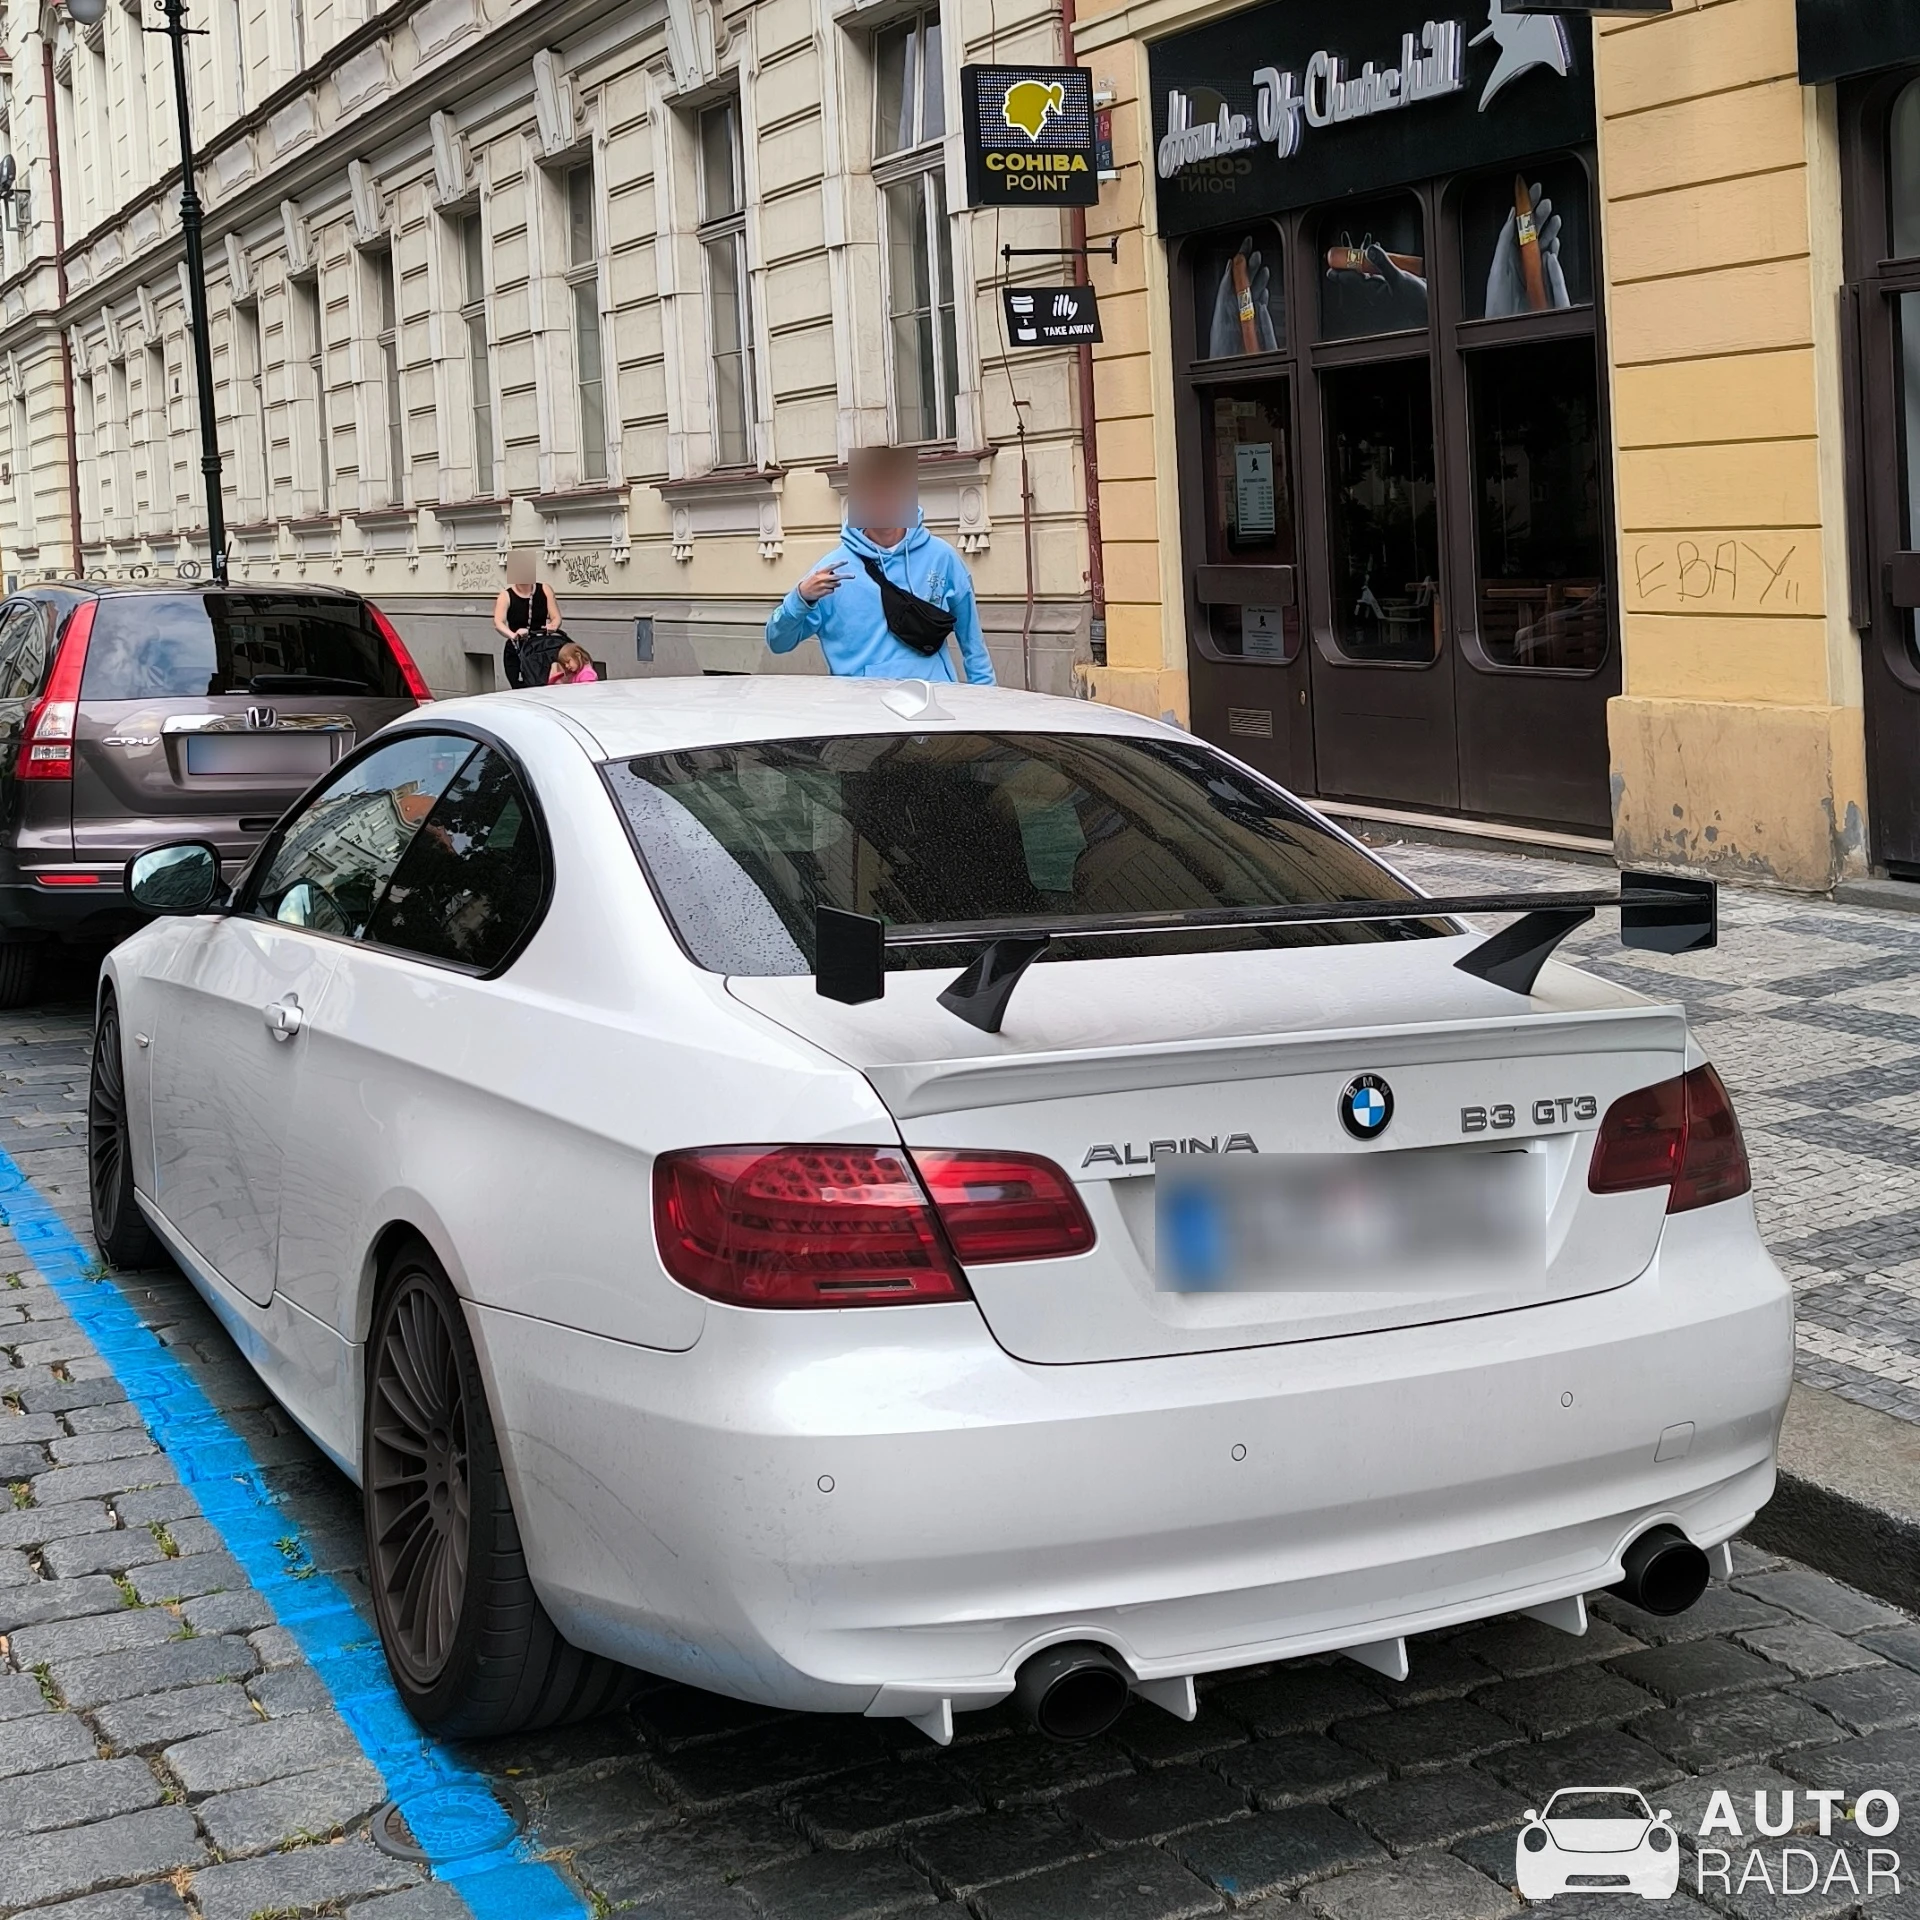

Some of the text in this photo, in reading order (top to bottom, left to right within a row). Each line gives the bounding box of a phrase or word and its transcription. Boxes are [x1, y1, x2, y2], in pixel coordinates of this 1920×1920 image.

[1158, 90, 1251, 178] House
[1253, 67, 1304, 158] Of
[1303, 20, 1457, 128] Churchill
[985, 153, 1089, 171] COHIBA
[1006, 174, 1071, 191] POINT
[1052, 294, 1078, 321] illy
[1043, 324, 1094, 337] TAKE AWAY
[1345, 1076, 1390, 1099] BMW
[1461, 1095, 1598, 1133] B3 GT3
